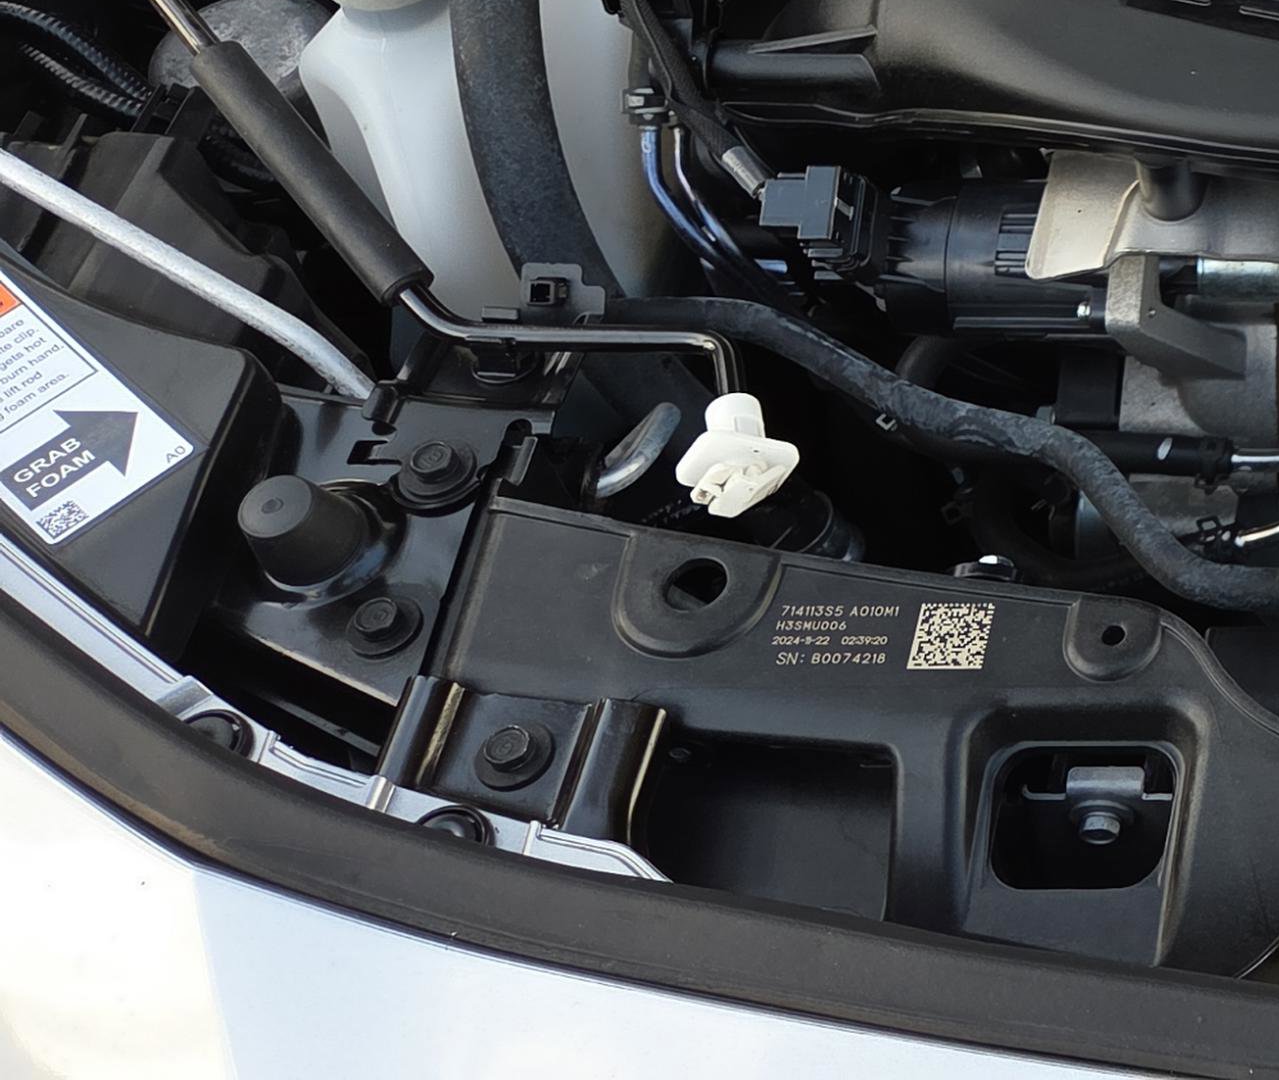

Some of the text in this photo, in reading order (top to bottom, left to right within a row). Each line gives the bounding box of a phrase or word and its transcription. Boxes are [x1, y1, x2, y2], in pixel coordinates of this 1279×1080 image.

[14, 328, 40, 344] clip.
[24, 336, 47, 353] hot
[0, 344, 65, 385] burn hand.
[3, 371, 43, 398] lift rod
[4, 374, 70, 414] foam area.
[13, 437, 82, 483] GRAB
[26, 450, 96, 498] FOAM
[781, 605, 900, 617] 714113S5 A010M1
[776, 620, 847, 631] H3SMU006
[776, 652, 886, 665] SN: B0074218
